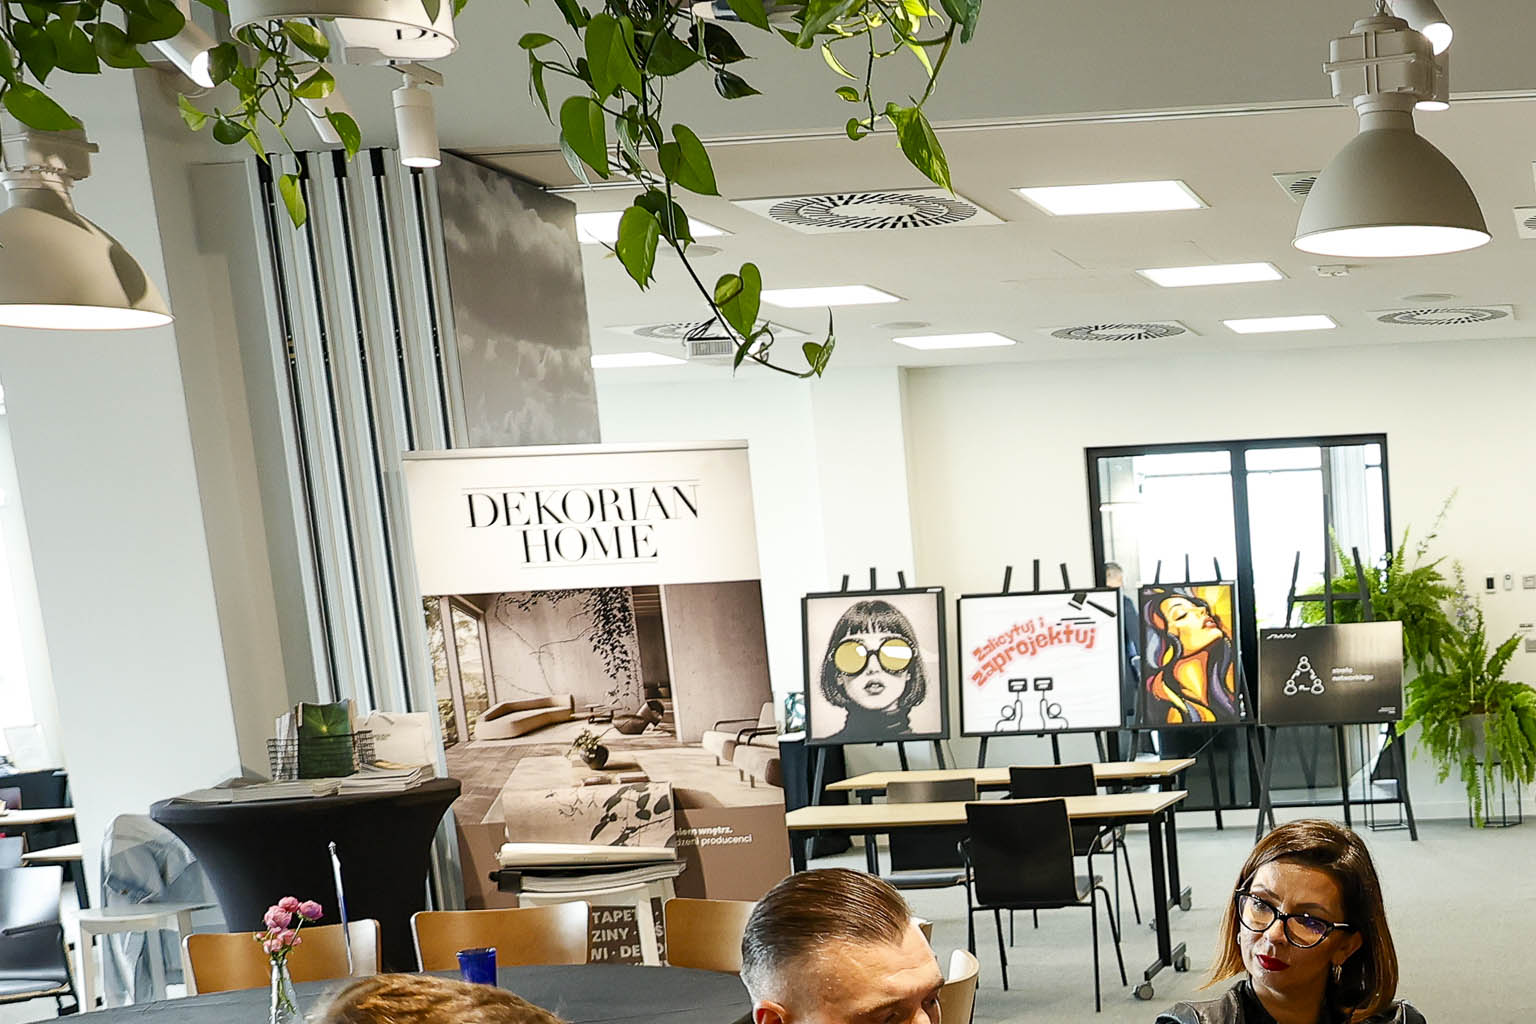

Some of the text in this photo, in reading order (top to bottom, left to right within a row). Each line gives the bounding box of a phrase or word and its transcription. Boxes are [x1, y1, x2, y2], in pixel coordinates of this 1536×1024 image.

[463, 484, 701, 528] DEKORIAN
[519, 523, 658, 563] HOME
[971, 624, 1098, 687] zaprojektuj
[972, 619, 1035, 662] zalicytuj
[698, 825, 734, 837] wnętrz.
[701, 833, 753, 848] producenci
[592, 909, 636, 925] TAPE
